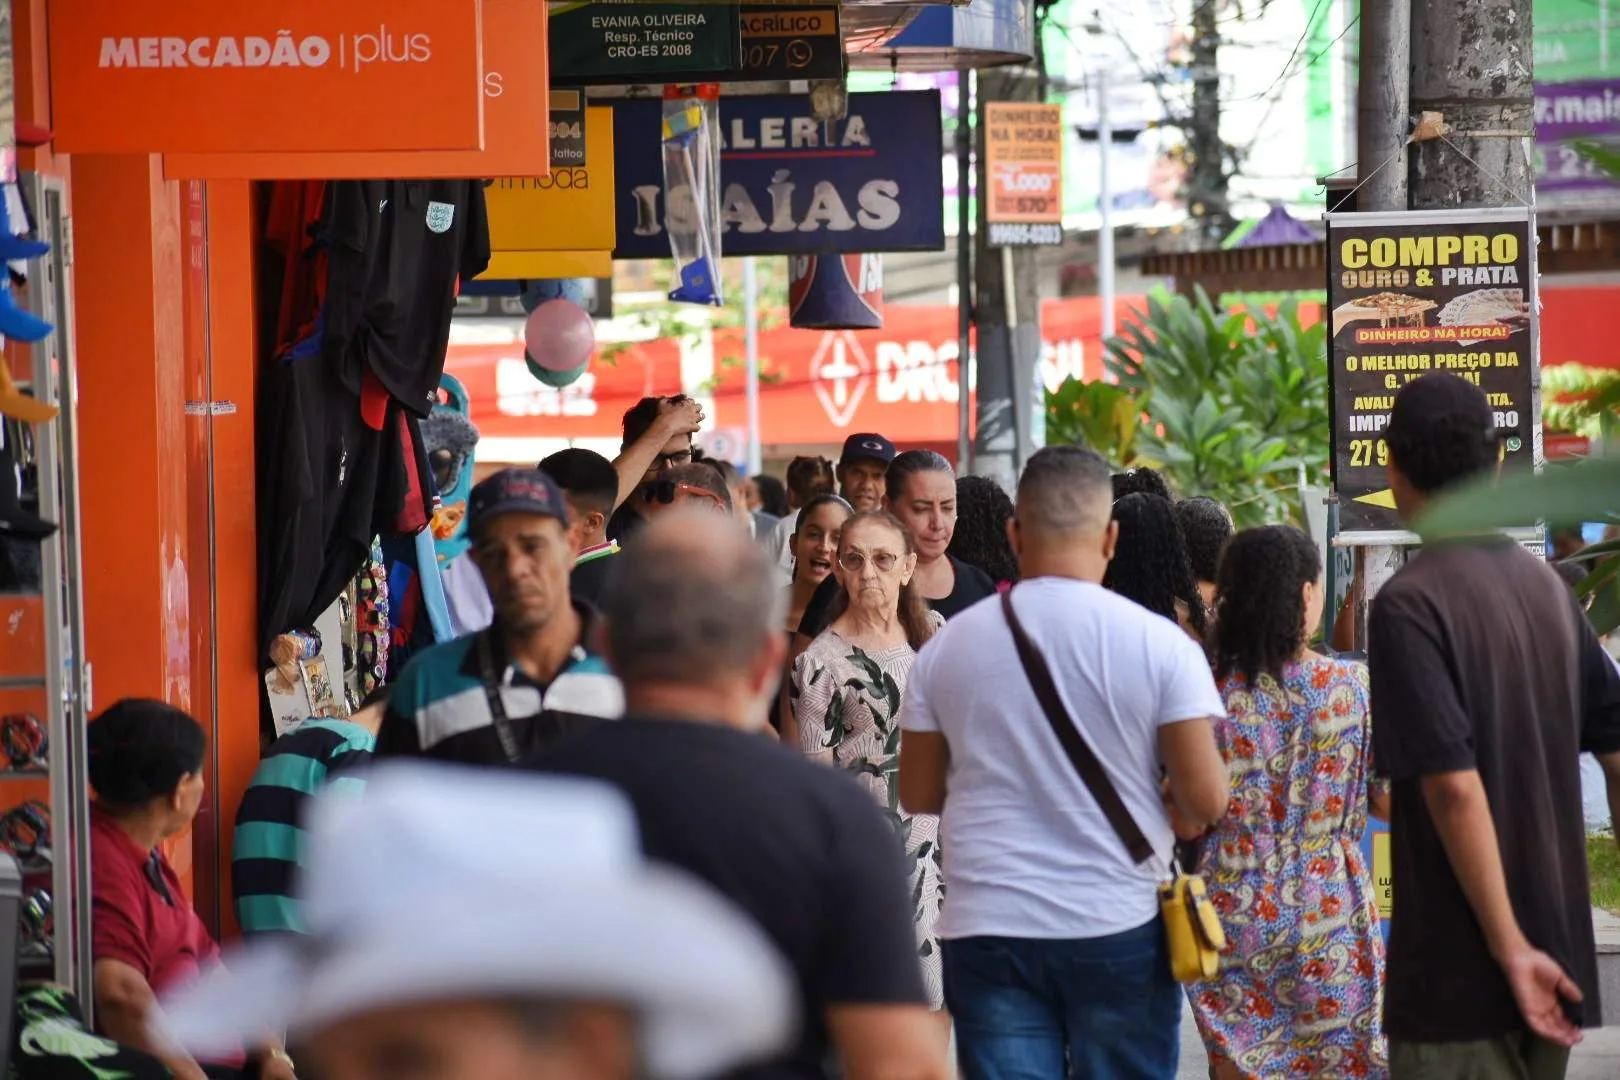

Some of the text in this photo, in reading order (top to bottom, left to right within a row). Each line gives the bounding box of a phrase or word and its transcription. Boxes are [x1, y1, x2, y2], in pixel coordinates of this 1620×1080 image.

[592, 13, 706, 28] EVANIA OLIVEIRA
[741, 14, 821, 32] ACRÍLICO
[604, 29, 694, 44] Resp. Técnico
[99, 24, 431, 73] MERCADÃO plus
[607, 44, 692, 57] CRO-ES 2008
[554, 148, 583, 158] tattoo
[632, 168, 901, 235] ISAÍAS
[1341, 233, 1518, 269] COMPRO
[1341, 265, 1519, 289] OURO & PRATA
[1359, 327, 1506, 341] DINHEIRO NA HORA!
[1346, 351, 1519, 371] O MELHOR PREÇO DA
[1384, 373, 1402, 389] G.
[1493, 410, 1519, 428] RO
[1350, 438, 1390, 467] 27 9
[1379, 876, 1392, 887] LU
